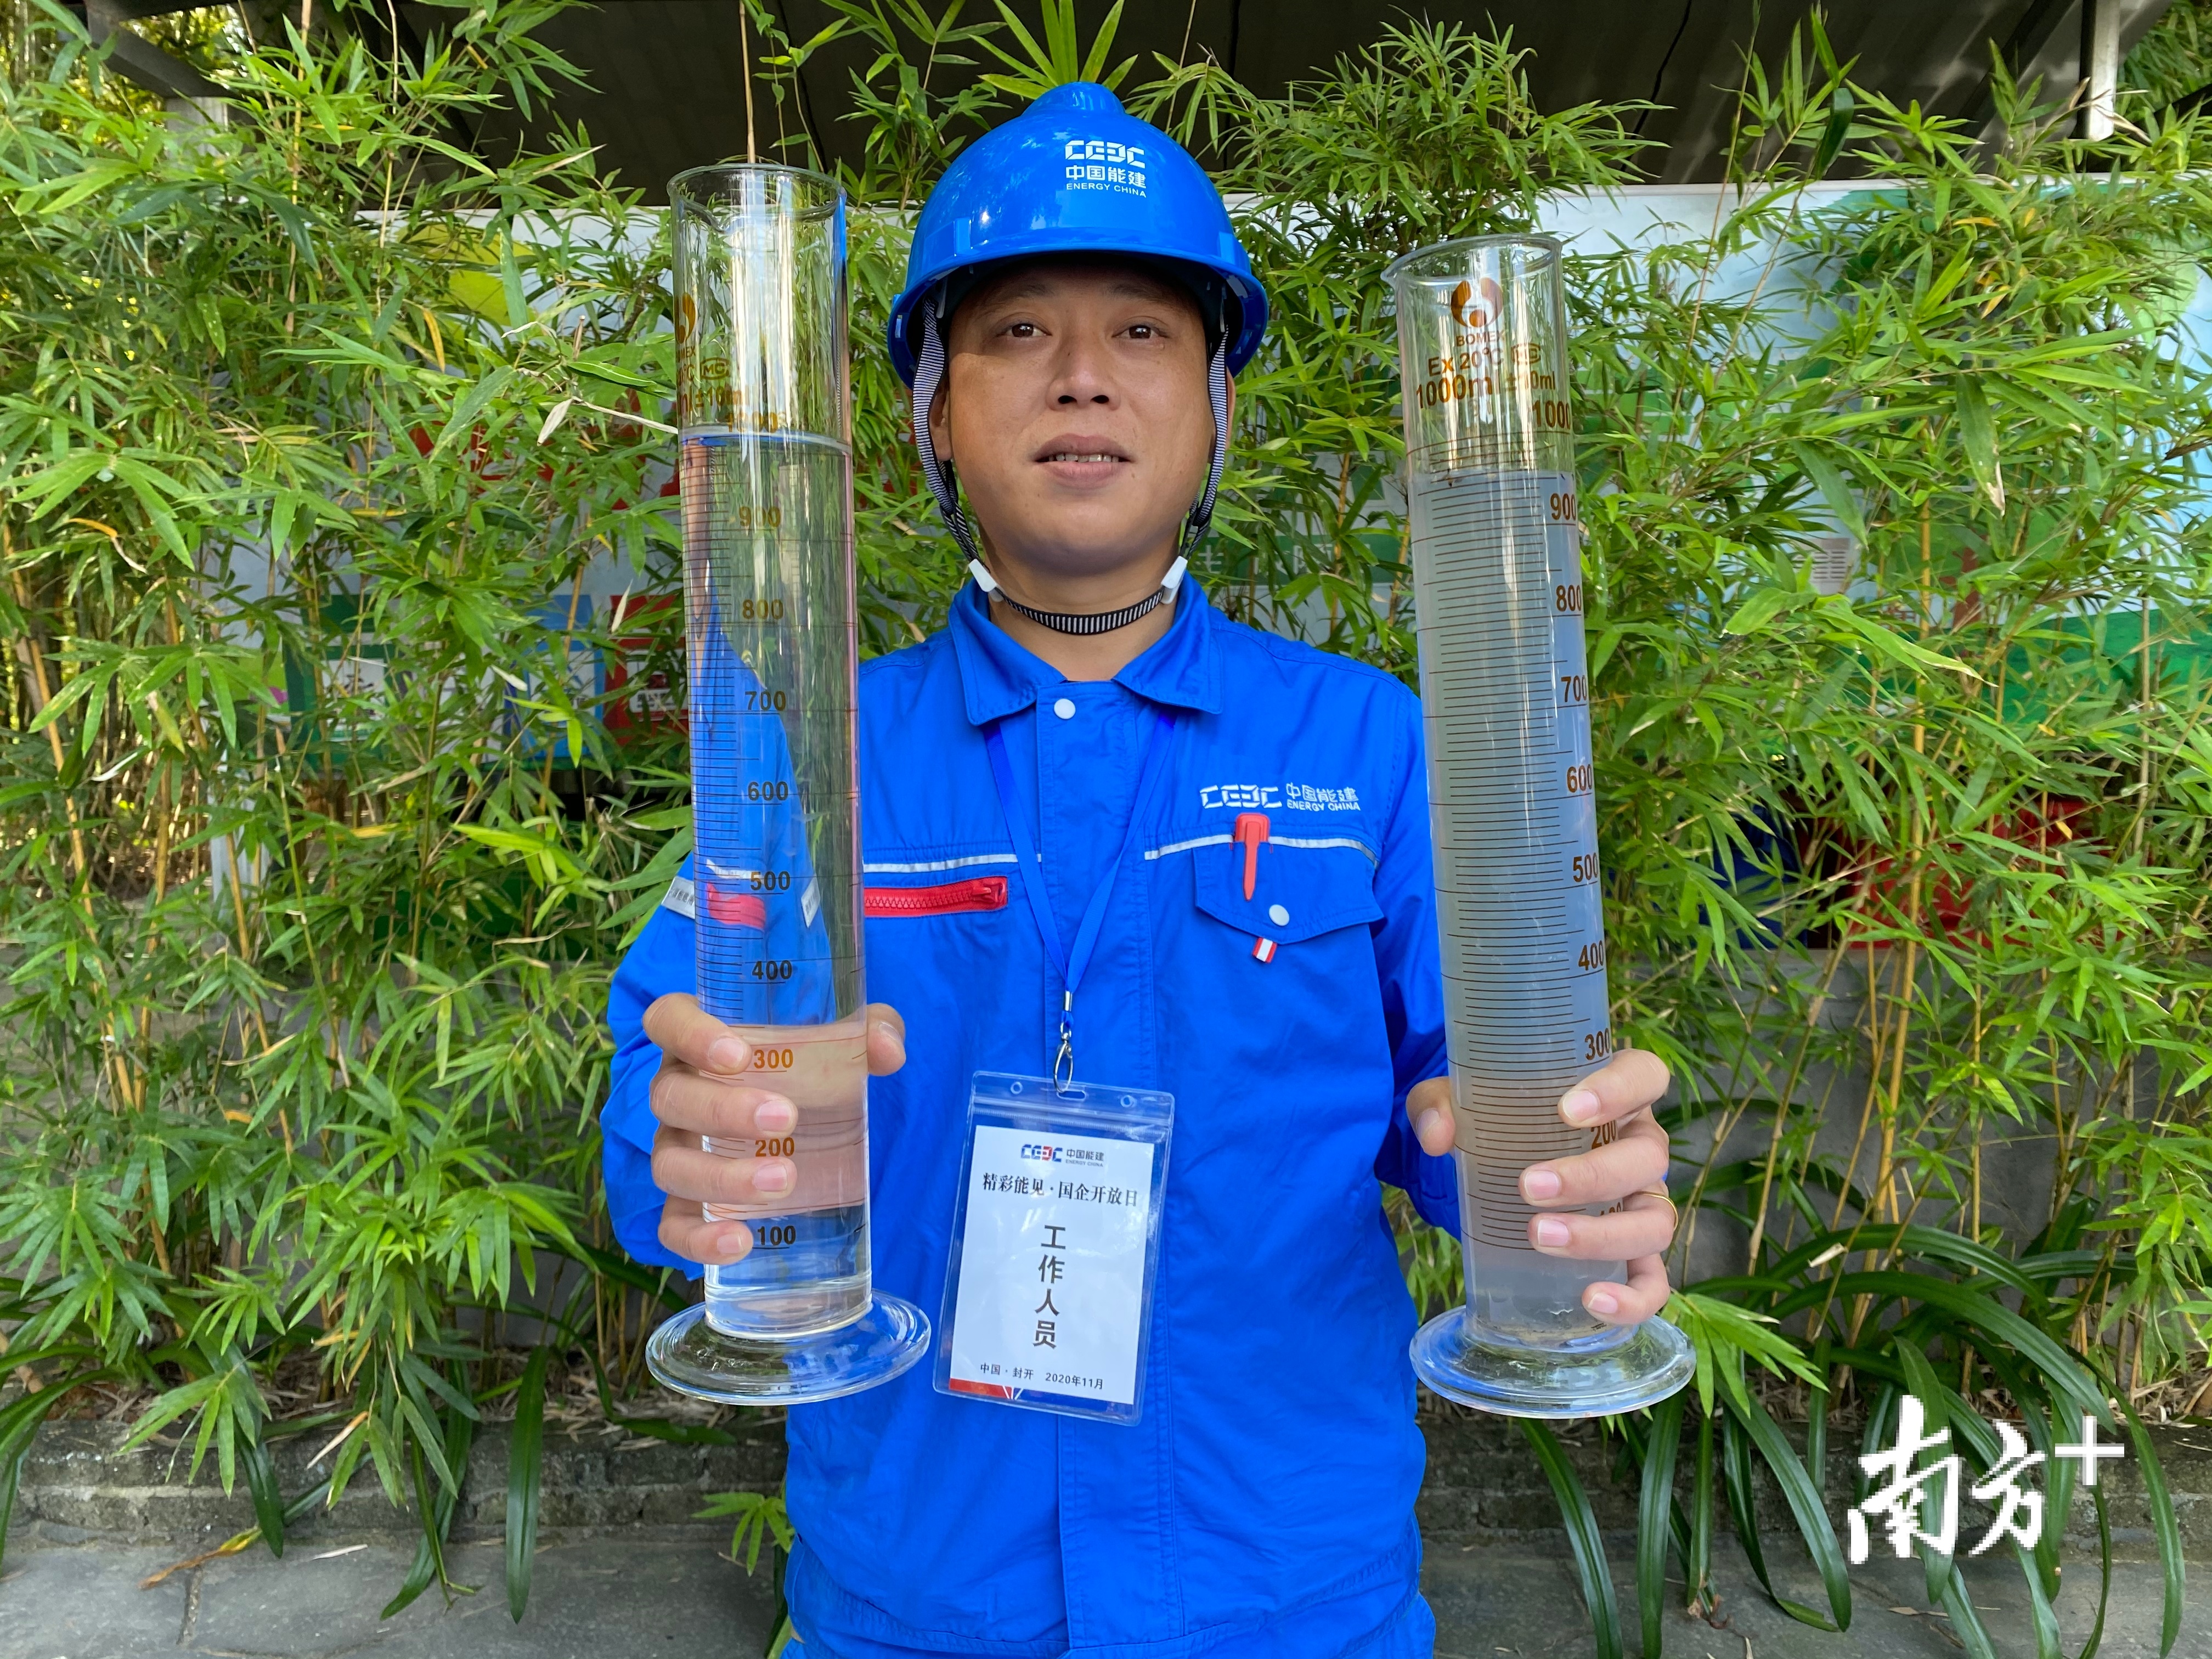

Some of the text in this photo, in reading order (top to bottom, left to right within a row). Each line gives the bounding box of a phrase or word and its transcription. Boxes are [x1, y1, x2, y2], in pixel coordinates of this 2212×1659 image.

[1065, 165, 1147, 189] 中国能建
[1066, 183, 1147, 198] ENERGY CHINA
[1428, 357, 1454, 377] Ex
[1532, 399, 1571, 430] 1000
[739, 506, 781, 527] 900
[1550, 493, 1576, 521] 900
[1555, 584, 1582, 612] 800
[742, 599, 784, 620] 800
[1561, 675, 1587, 703] 700
[744, 691, 786, 712] 700
[1566, 764, 1593, 793] 600
[748, 781, 788, 801] 600
[1286, 782, 1359, 803] 中国能建
[1286, 799, 1361, 811] ENERGY CHINA
[1573, 852, 1599, 882] 500
[750, 871, 791, 890] 500
[1578, 940, 1604, 971] 400
[752, 960, 792, 980] 400
[1584, 1028, 1610, 1061] 300
[753, 1049, 794, 1069] 300
[1590, 1120, 1616, 1150] 200
[755, 1137, 795, 1158] 200
[1066, 1149, 1104, 1161] 中国能建
[757, 1226, 797, 1245] 100
[1032, 1224, 1066, 1350] 工作人员
[1045, 1373, 1104, 1390] 2020年11月
